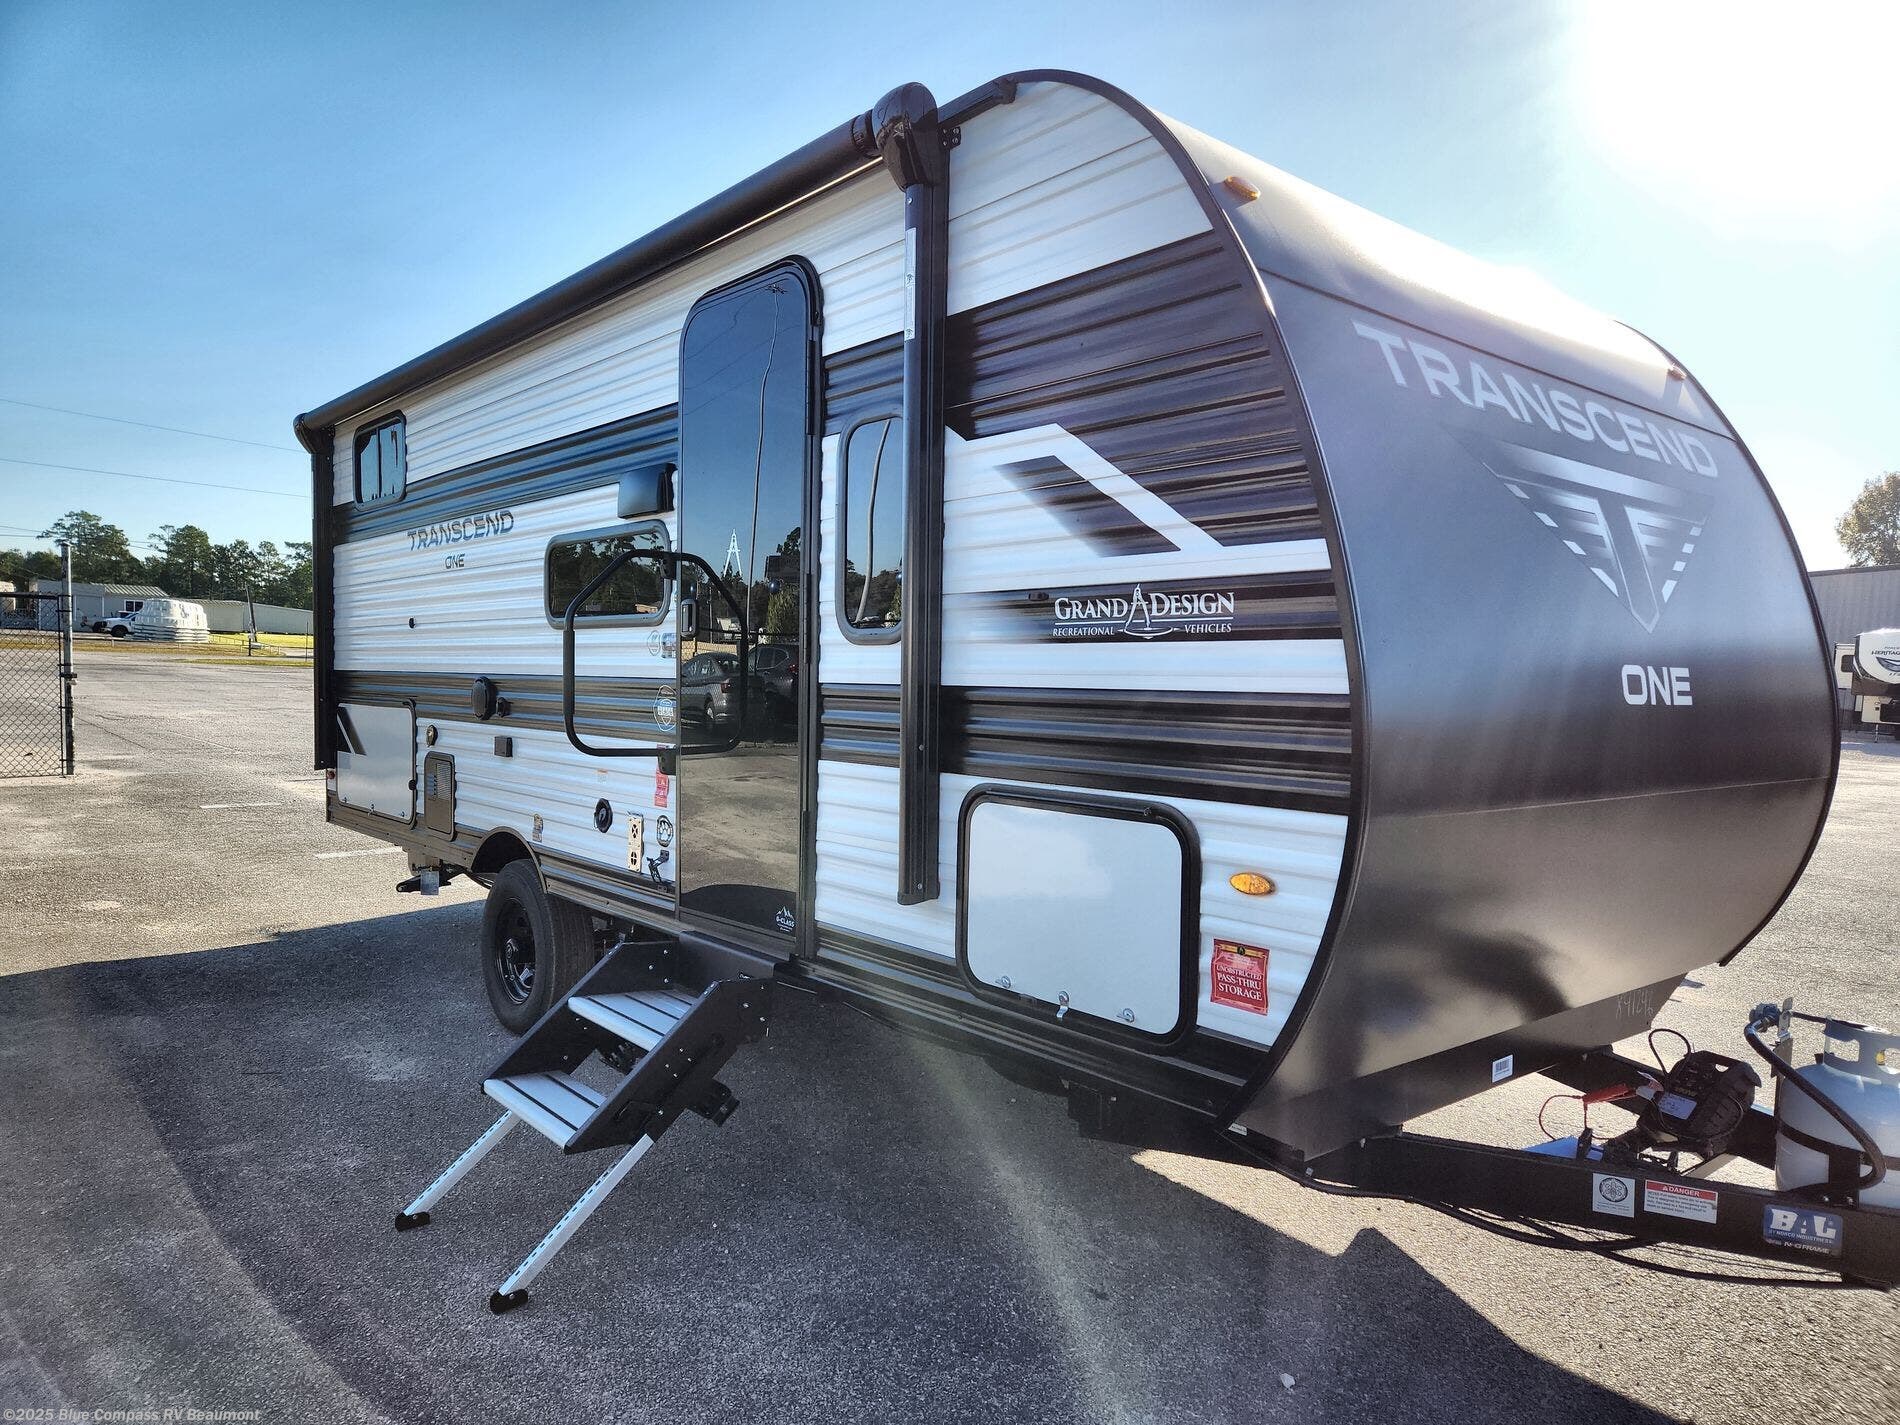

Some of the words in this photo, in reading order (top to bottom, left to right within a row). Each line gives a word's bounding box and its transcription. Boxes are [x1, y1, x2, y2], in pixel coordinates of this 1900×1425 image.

[1351, 318, 1719, 478] TRANSCEND
[407, 509, 515, 552] TRANSCEND
[444, 552, 466, 570] ONE
[1054, 597, 1129, 620] GRAND
[1148, 591, 1236, 617] DESIGN
[1052, 626, 1115, 637] RECREATIONAL
[1184, 622, 1232, 634] VEHICLES
[1621, 663, 1693, 706] ONE
[1217, 972, 1262, 990] PASS-THRU
[1218, 982, 1262, 1000] STORAGE
[1668, 1186, 1701, 1198] DANGER
